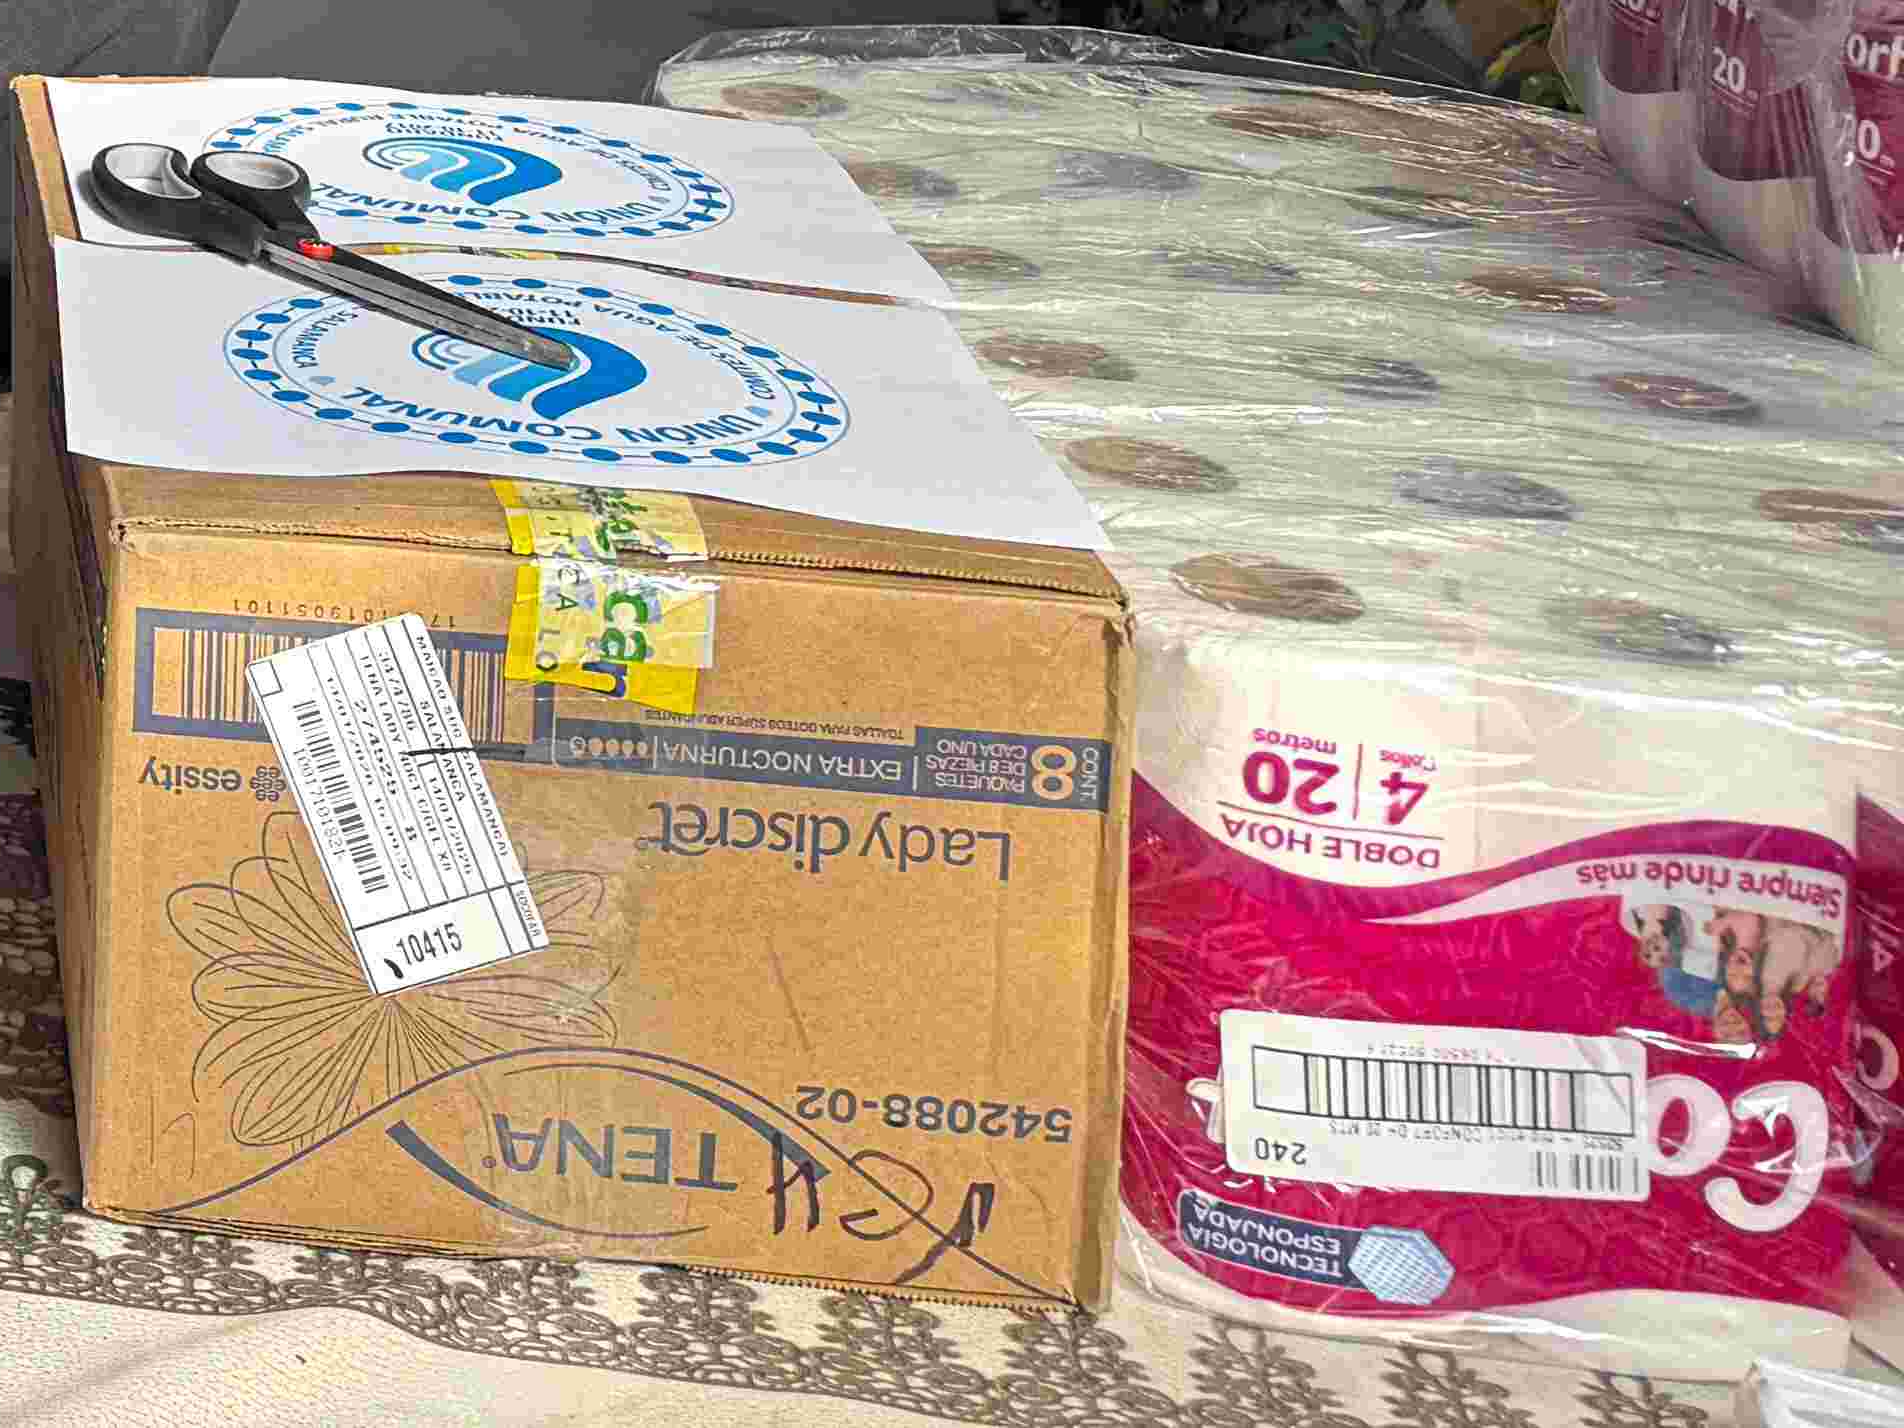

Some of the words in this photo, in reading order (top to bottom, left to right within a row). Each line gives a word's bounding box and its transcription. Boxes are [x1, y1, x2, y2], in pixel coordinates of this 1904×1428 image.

[1713, 47, 1746, 94] 20
[310, 183, 530, 221] COMUNAL
[454, 292, 584, 307] POTABL
[594, 304, 678, 333] AGUA
[289, 310, 360, 369] SALAMANCA
[342, 385, 602, 442] COMUNAL
[617, 412, 761, 445] UNIÓN
[352, 698, 401, 797] 274525
[662, 743, 812, 778] NOCTURNA
[936, 738, 976, 757] UNO
[980, 741, 1026, 761] CADA
[1253, 727, 1337, 755] metros
[138, 755, 242, 794] essity
[818, 754, 903, 782] EXTRA
[926, 754, 985, 775] PIEZAS
[935, 772, 1026, 793] PAQUETES
[1030, 744, 1077, 801] 8
[1080, 746, 1100, 802] CONT.
[1242, 750, 1340, 815] 20
[1379, 771, 1430, 825] 4
[859, 811, 1011, 885] Lady
[1220, 813, 1312, 855] HOJA
[1322, 835, 1441, 869] DOBLE
[1576, 860, 1637, 890] más
[1644, 860, 1732, 894] rinde
[1737, 868, 1843, 921] Siempre
[395, 921, 464, 969] 10415
[795, 1085, 1073, 1144] 542088-02
[494, 1112, 739, 1192] TENA
[1254, 1137, 1307, 1166] 240
[1192, 1201, 1342, 1255] ESPONJADA
[1184, 1222, 1344, 1277] TECNOLOGÍA
